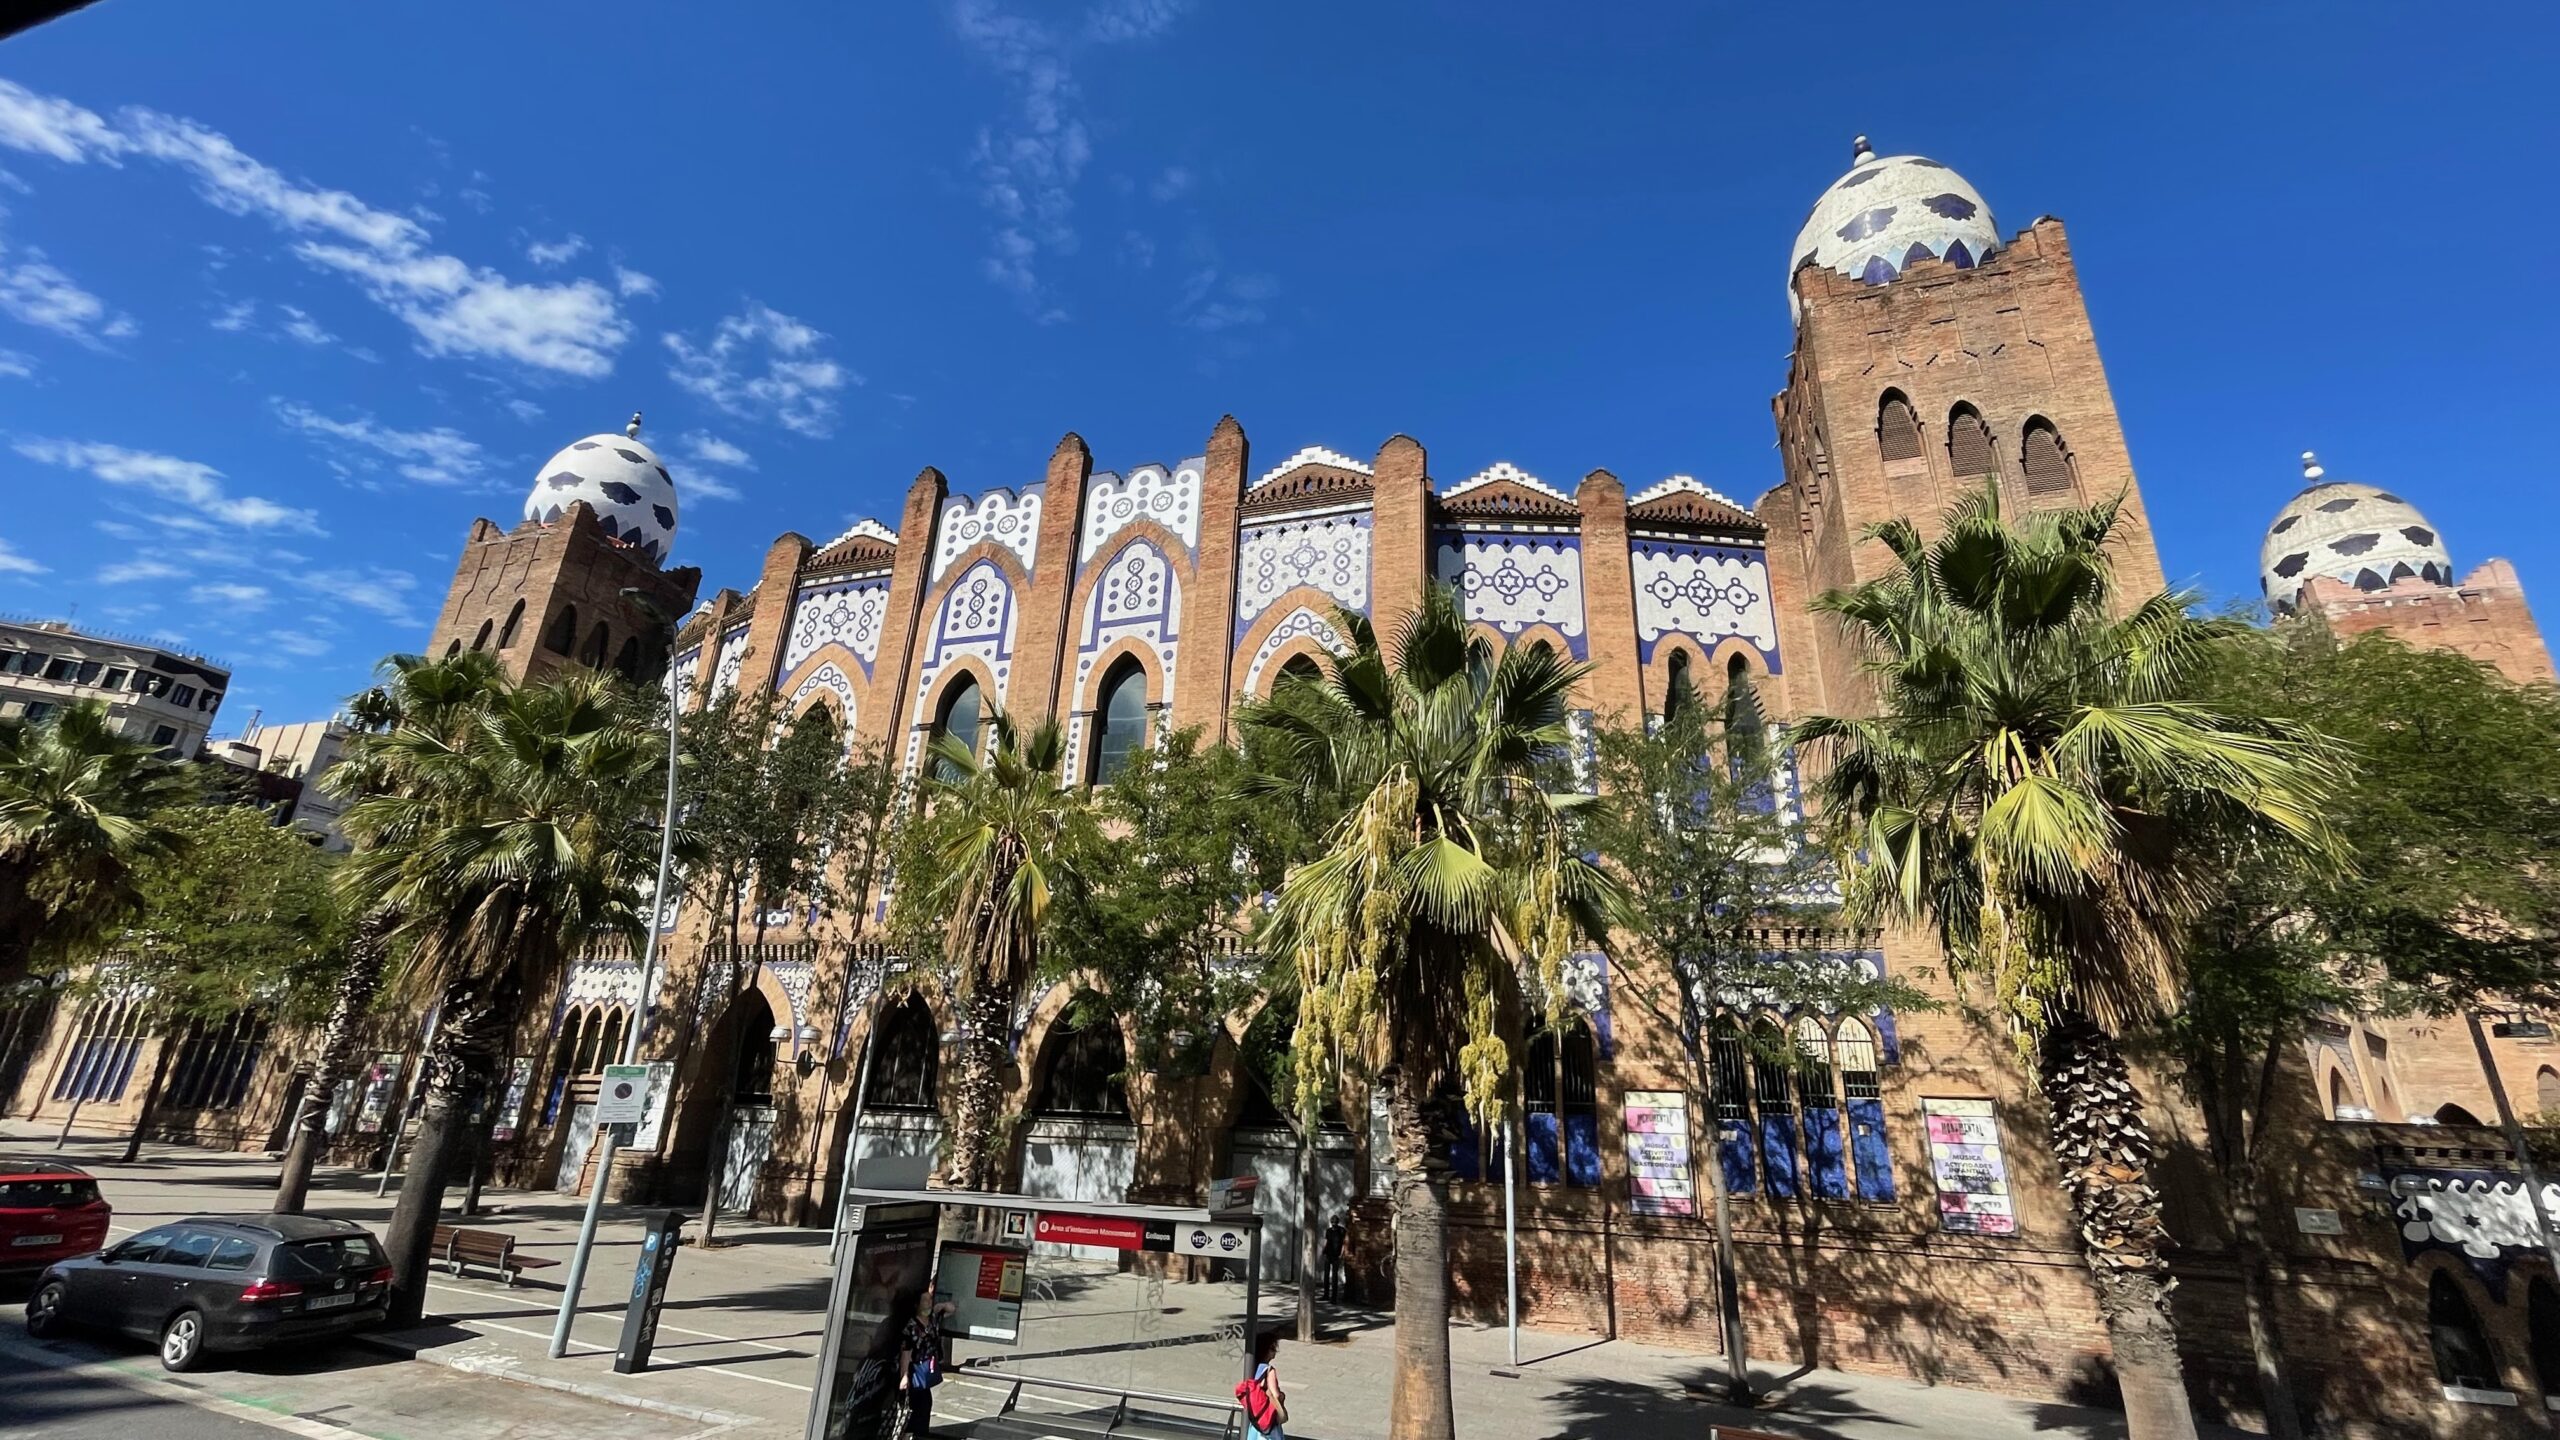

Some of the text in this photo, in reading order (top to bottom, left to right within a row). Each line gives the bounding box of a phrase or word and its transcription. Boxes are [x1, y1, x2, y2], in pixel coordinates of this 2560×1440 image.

[1941, 1122, 1984, 1137] MONUMENTAL
[1192, 1235, 1206, 1244] H12
[1221, 1237, 1236, 1246] H12
